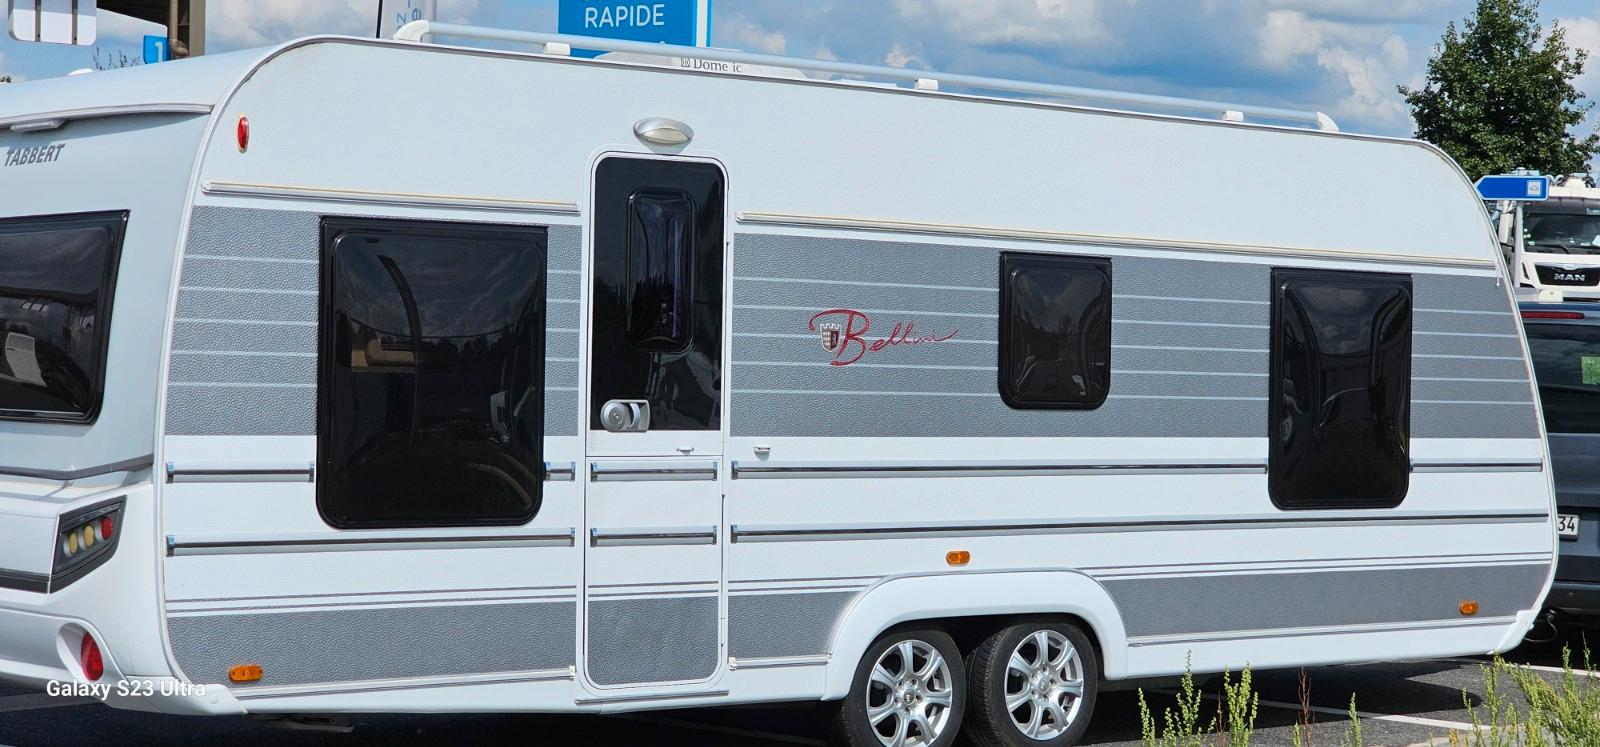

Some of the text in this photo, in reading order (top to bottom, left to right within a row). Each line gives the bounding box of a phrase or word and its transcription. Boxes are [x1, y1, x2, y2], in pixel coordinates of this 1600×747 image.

[584, 3, 665, 29] RAPIDE
[693, 57, 743, 73] Domeic
[4, 143, 66, 167] TABBERT
[1554, 273, 1586, 282] MAN
[808, 308, 959, 367] Bellini
